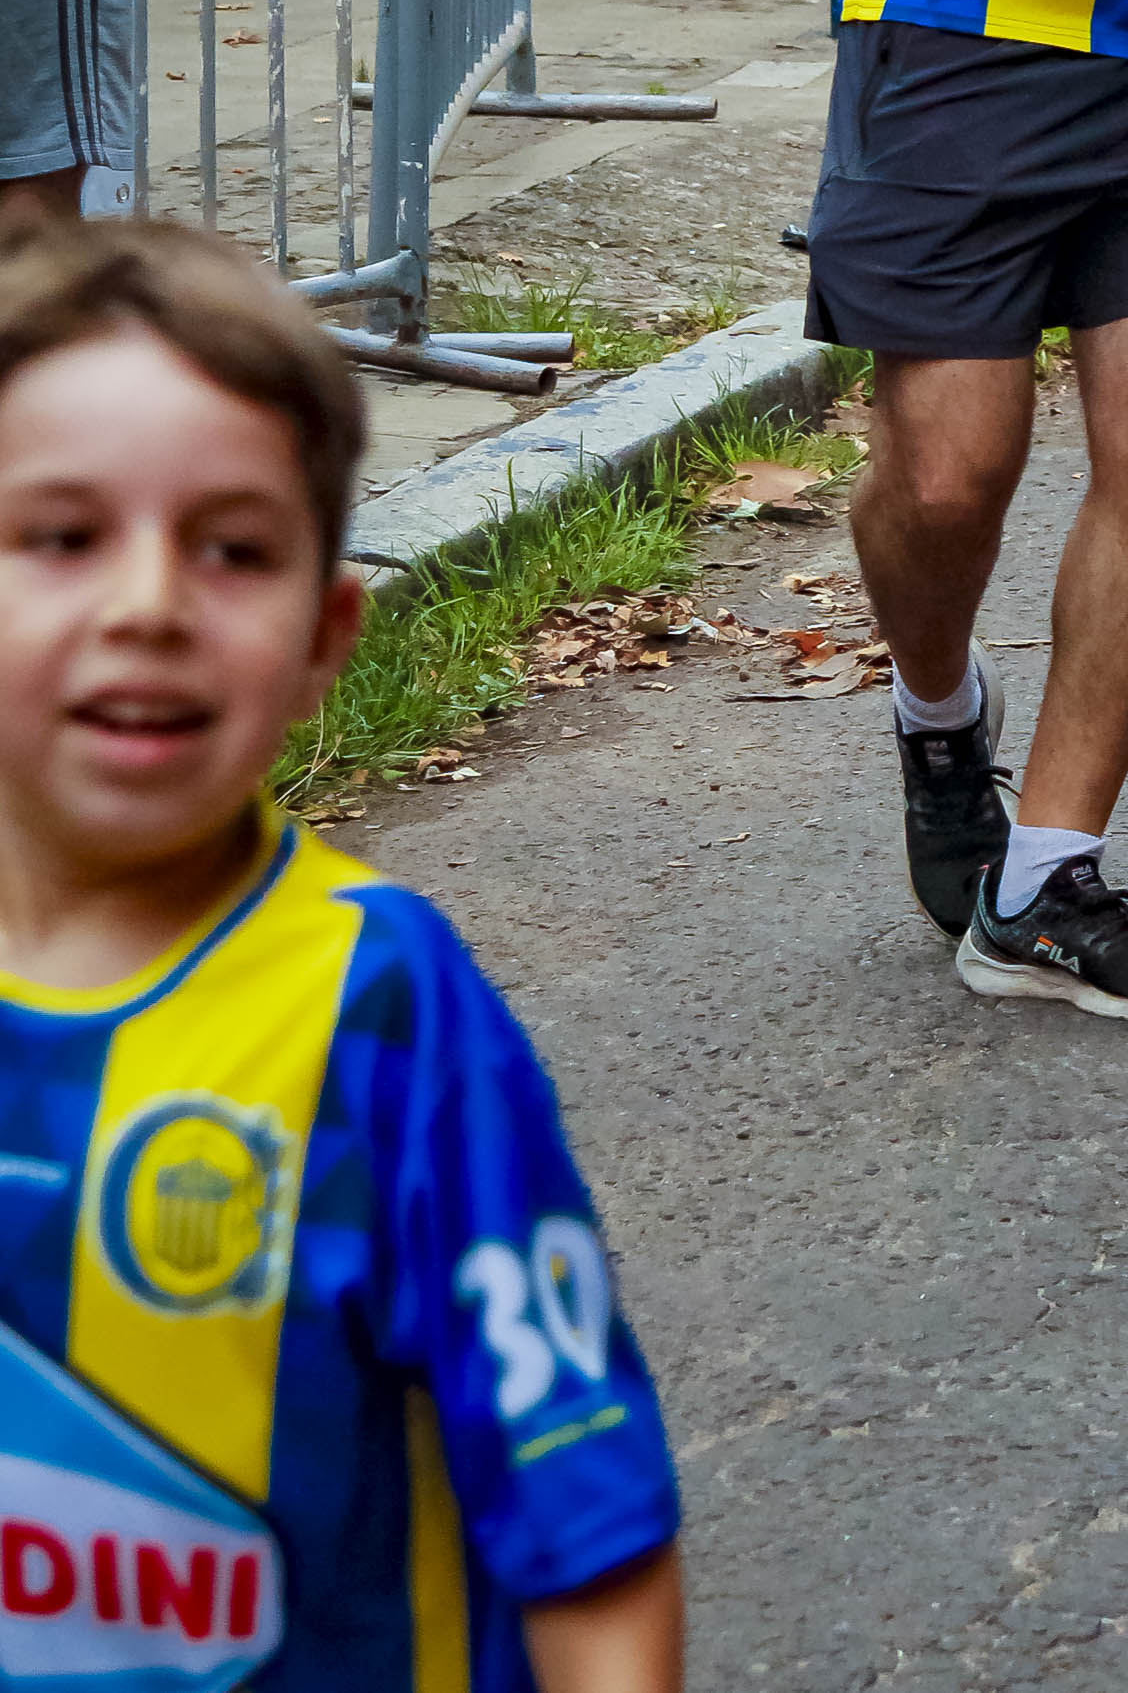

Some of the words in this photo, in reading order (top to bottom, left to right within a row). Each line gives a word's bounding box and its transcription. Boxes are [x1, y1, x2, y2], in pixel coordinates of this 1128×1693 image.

[1071, 864, 1093, 879] FILA
[1033, 935, 1081, 975] FILA
[454, 1214, 612, 1421] 30
[0, 1517, 262, 1642] DINI
